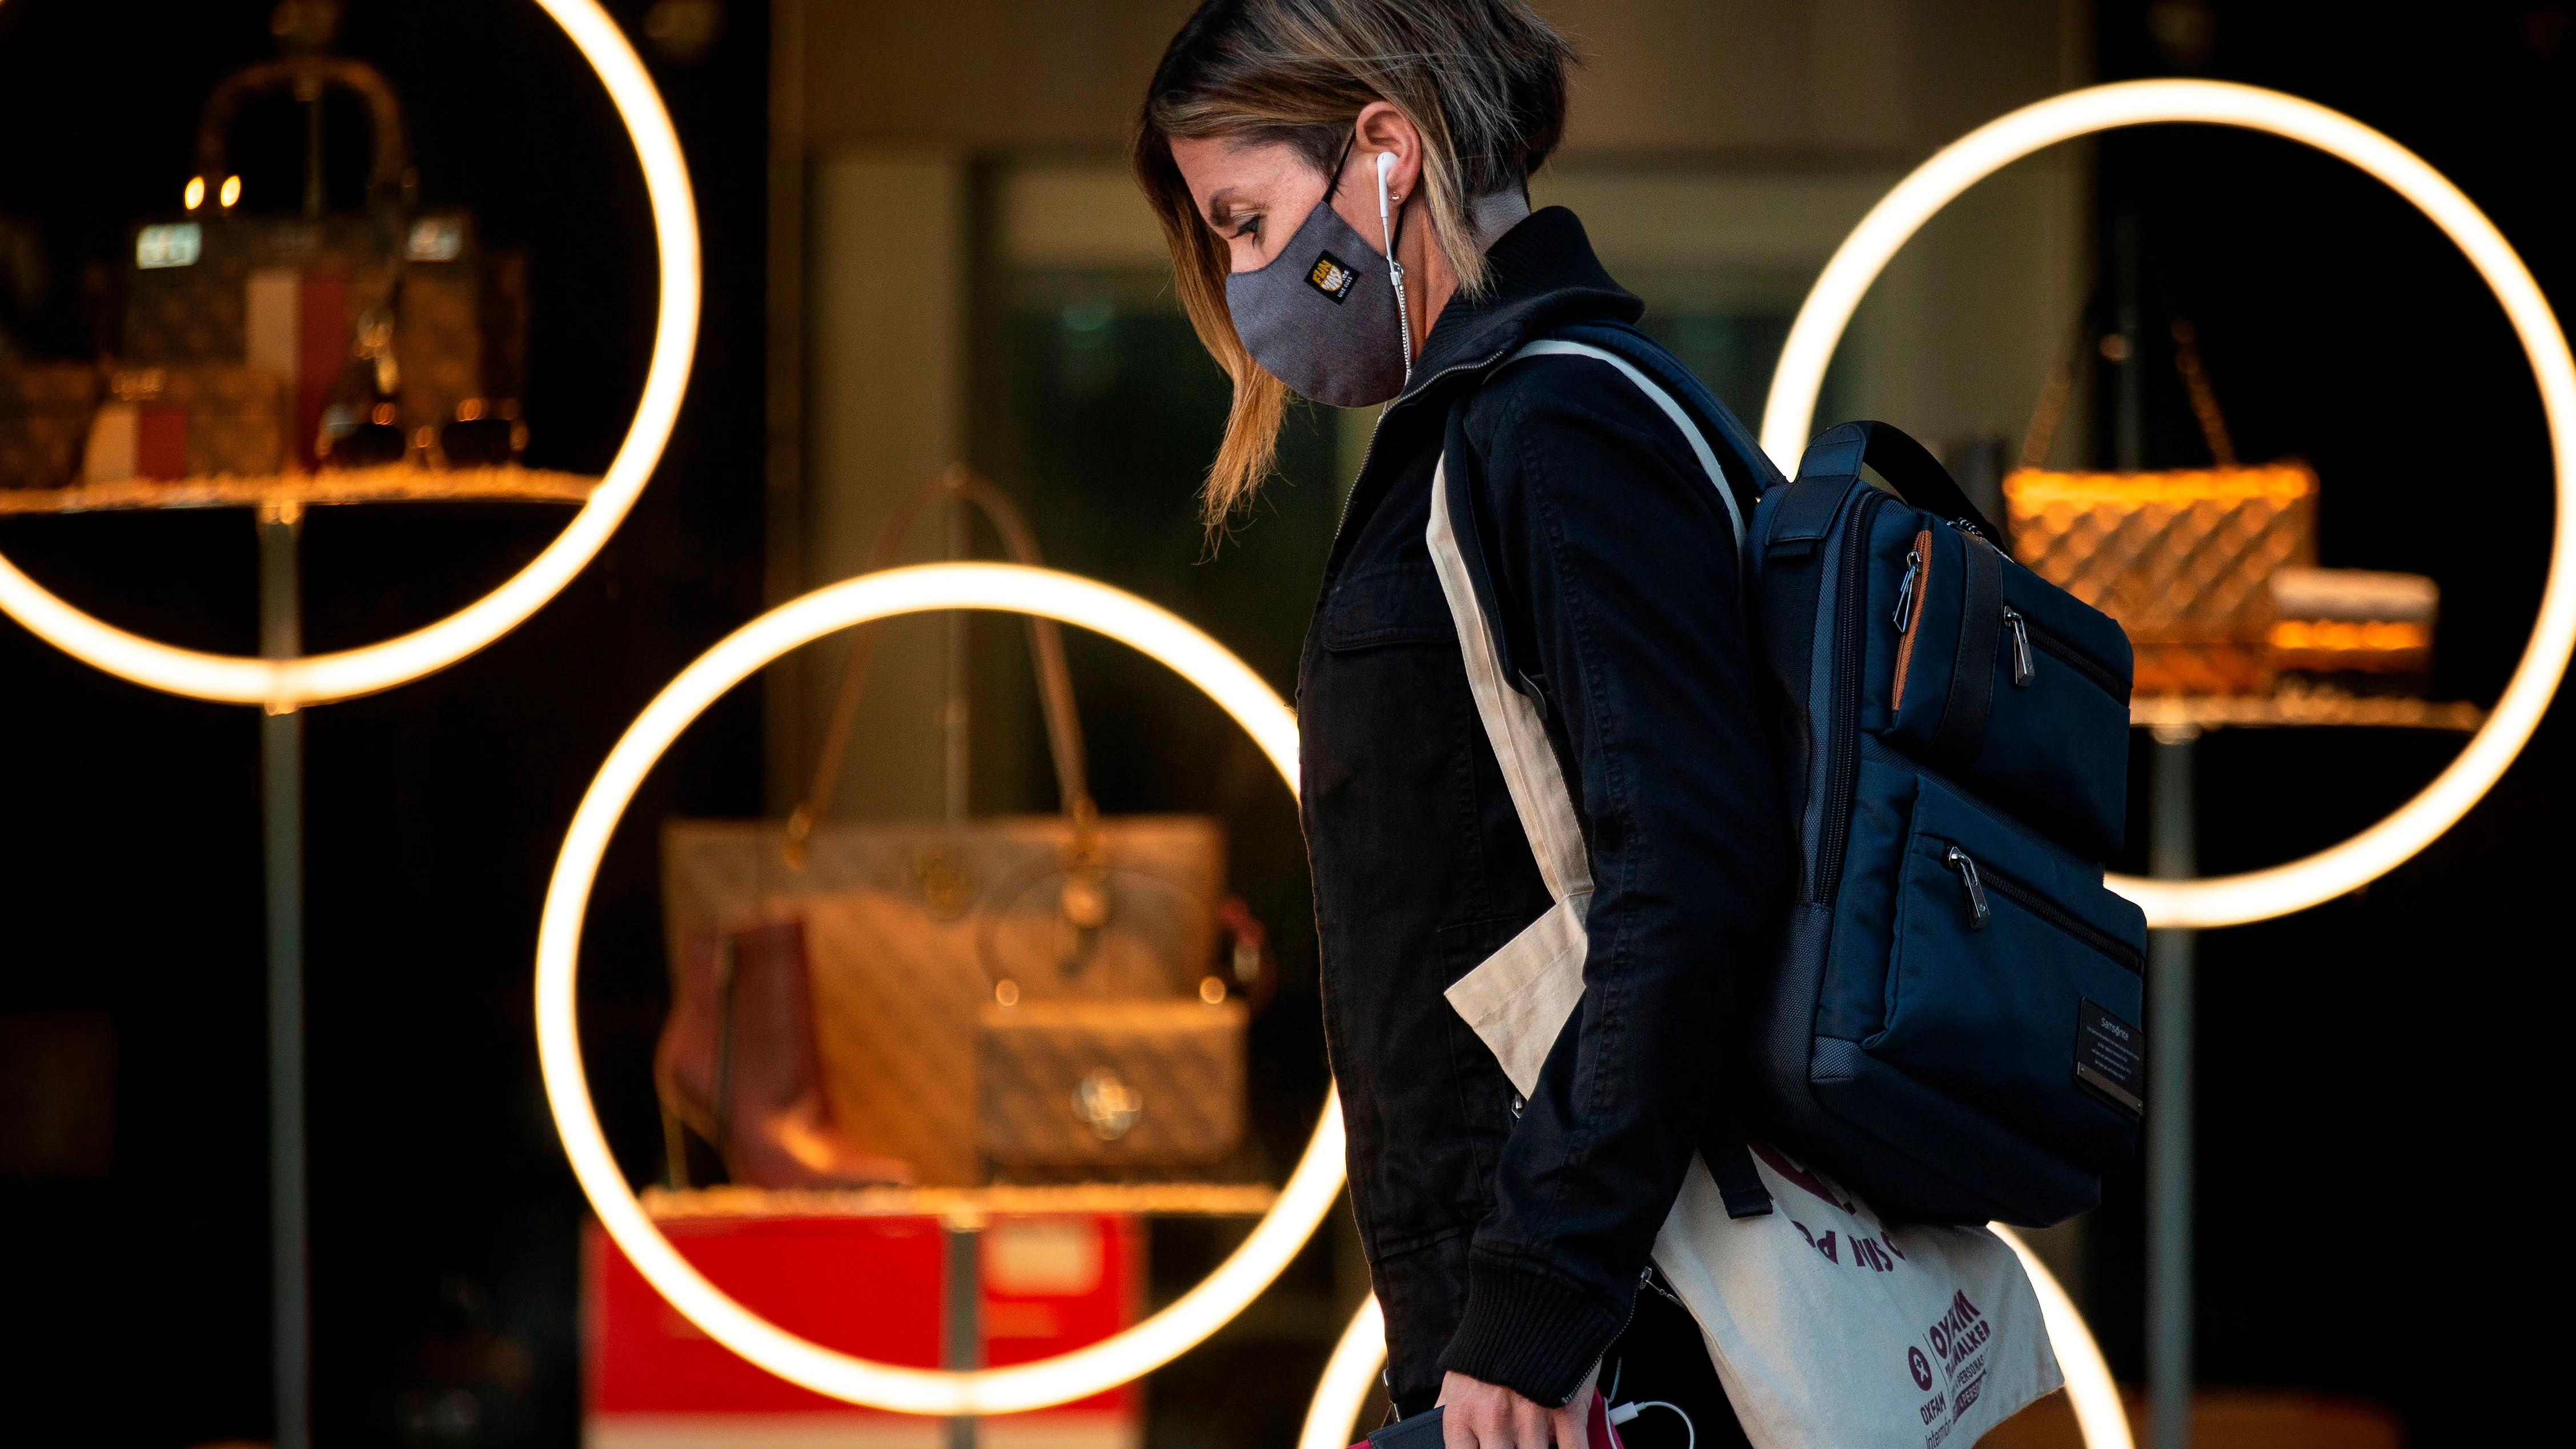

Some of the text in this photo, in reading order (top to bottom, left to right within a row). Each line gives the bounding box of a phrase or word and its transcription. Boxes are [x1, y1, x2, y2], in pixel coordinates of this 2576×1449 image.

[1313, 260, 1332, 284] FUN
[1847, 1234, 1893, 1272] SIN
[1920, 1391, 1947, 1426] OXFAM
